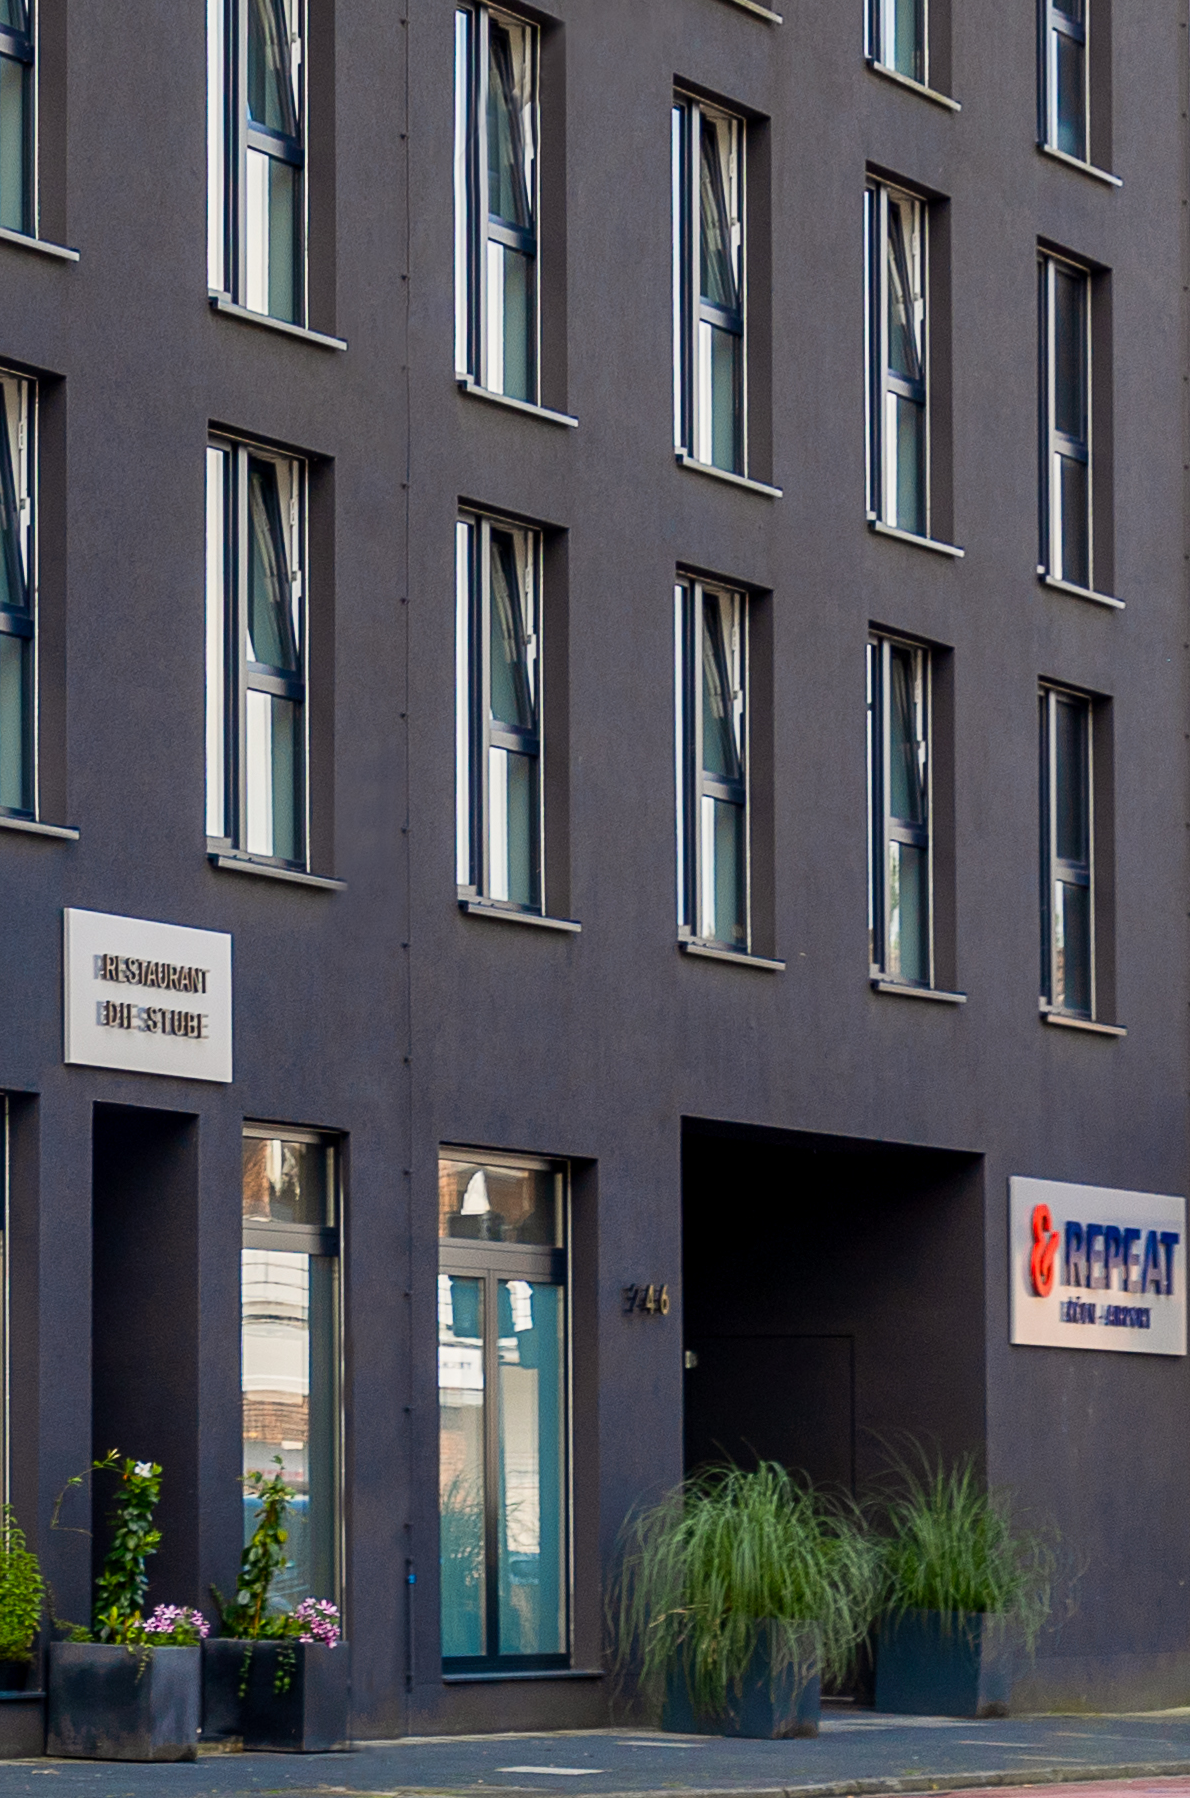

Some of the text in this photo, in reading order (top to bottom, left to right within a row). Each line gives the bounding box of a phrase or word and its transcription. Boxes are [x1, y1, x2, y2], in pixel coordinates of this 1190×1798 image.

[101, 953, 210, 994] RESTAURANT
[145, 1006, 210, 1039] STUBE
[1030, 1203, 1180, 1298] & REPEAT
